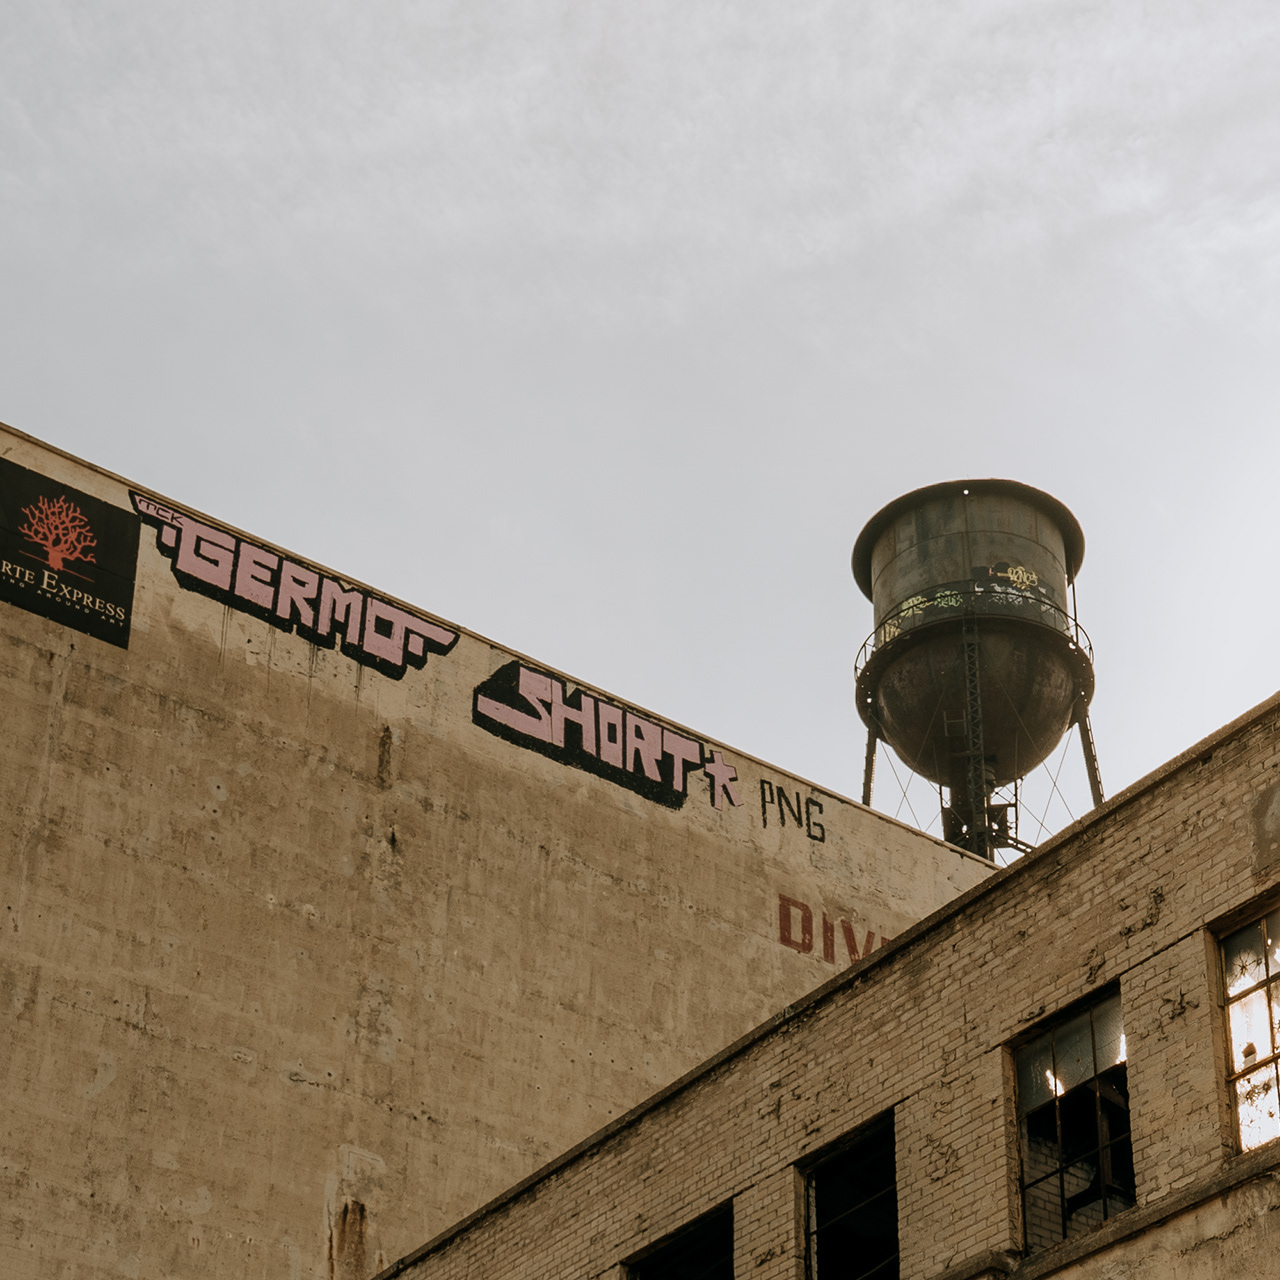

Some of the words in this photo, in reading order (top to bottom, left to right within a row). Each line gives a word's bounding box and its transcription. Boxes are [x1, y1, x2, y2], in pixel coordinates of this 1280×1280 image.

[36, 589, 90, 614] AROUND
[100, 615, 124, 628] ART
[759, 778, 826, 844] PNG
[778, 893, 890, 965] DIV
